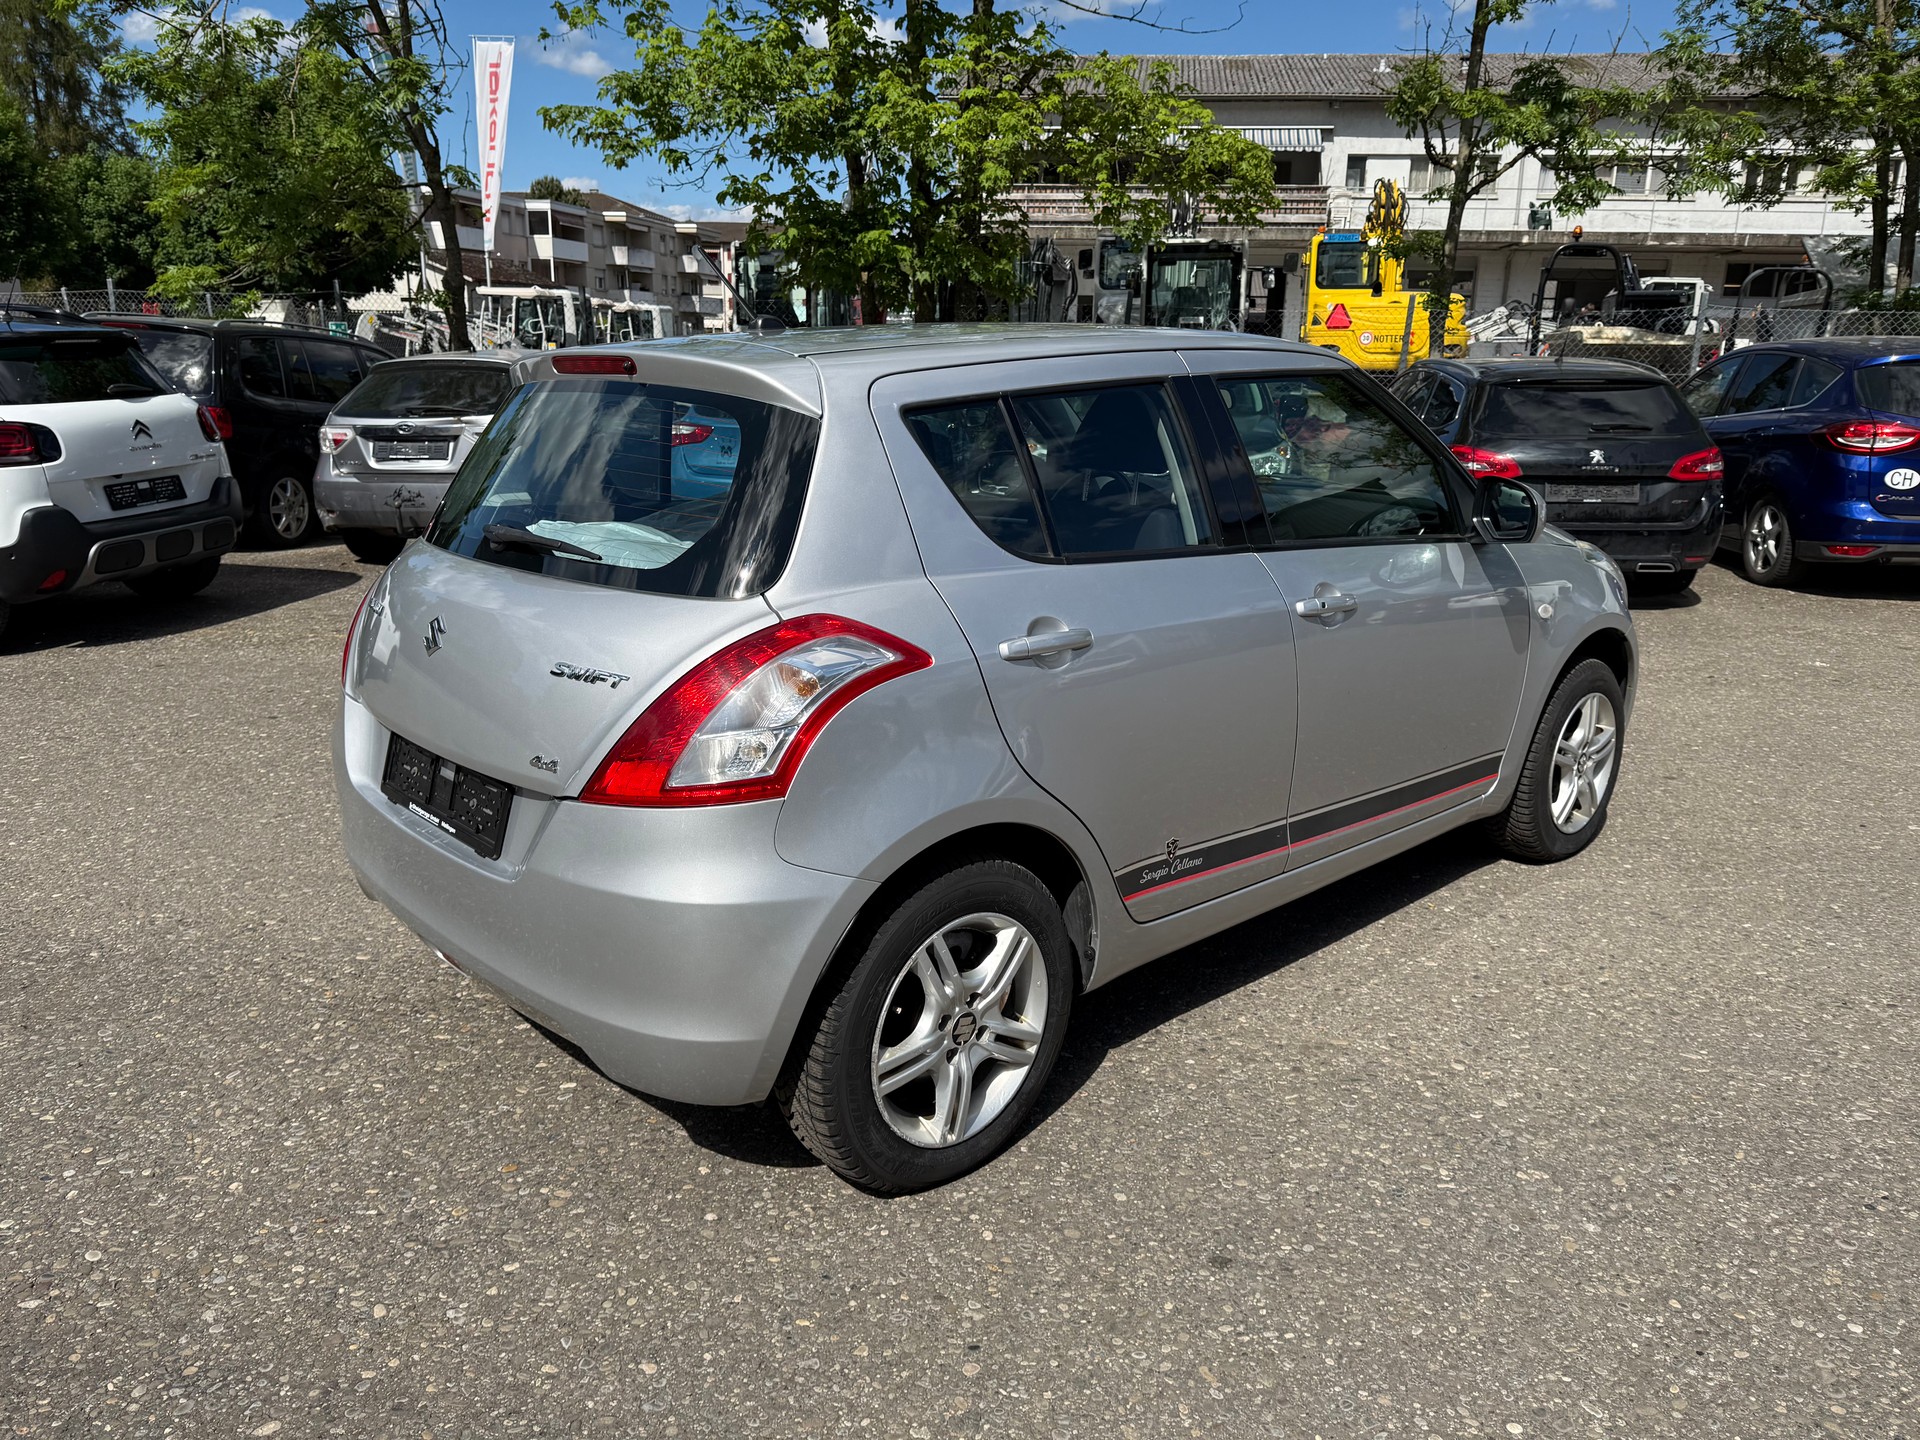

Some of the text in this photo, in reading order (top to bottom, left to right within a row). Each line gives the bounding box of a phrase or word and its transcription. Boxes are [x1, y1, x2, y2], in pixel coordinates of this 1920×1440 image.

[1890, 471, 1914, 487] CH
[549, 661, 631, 690] SWIFT
[1139, 856, 1203, 884] Sergio Cellano
